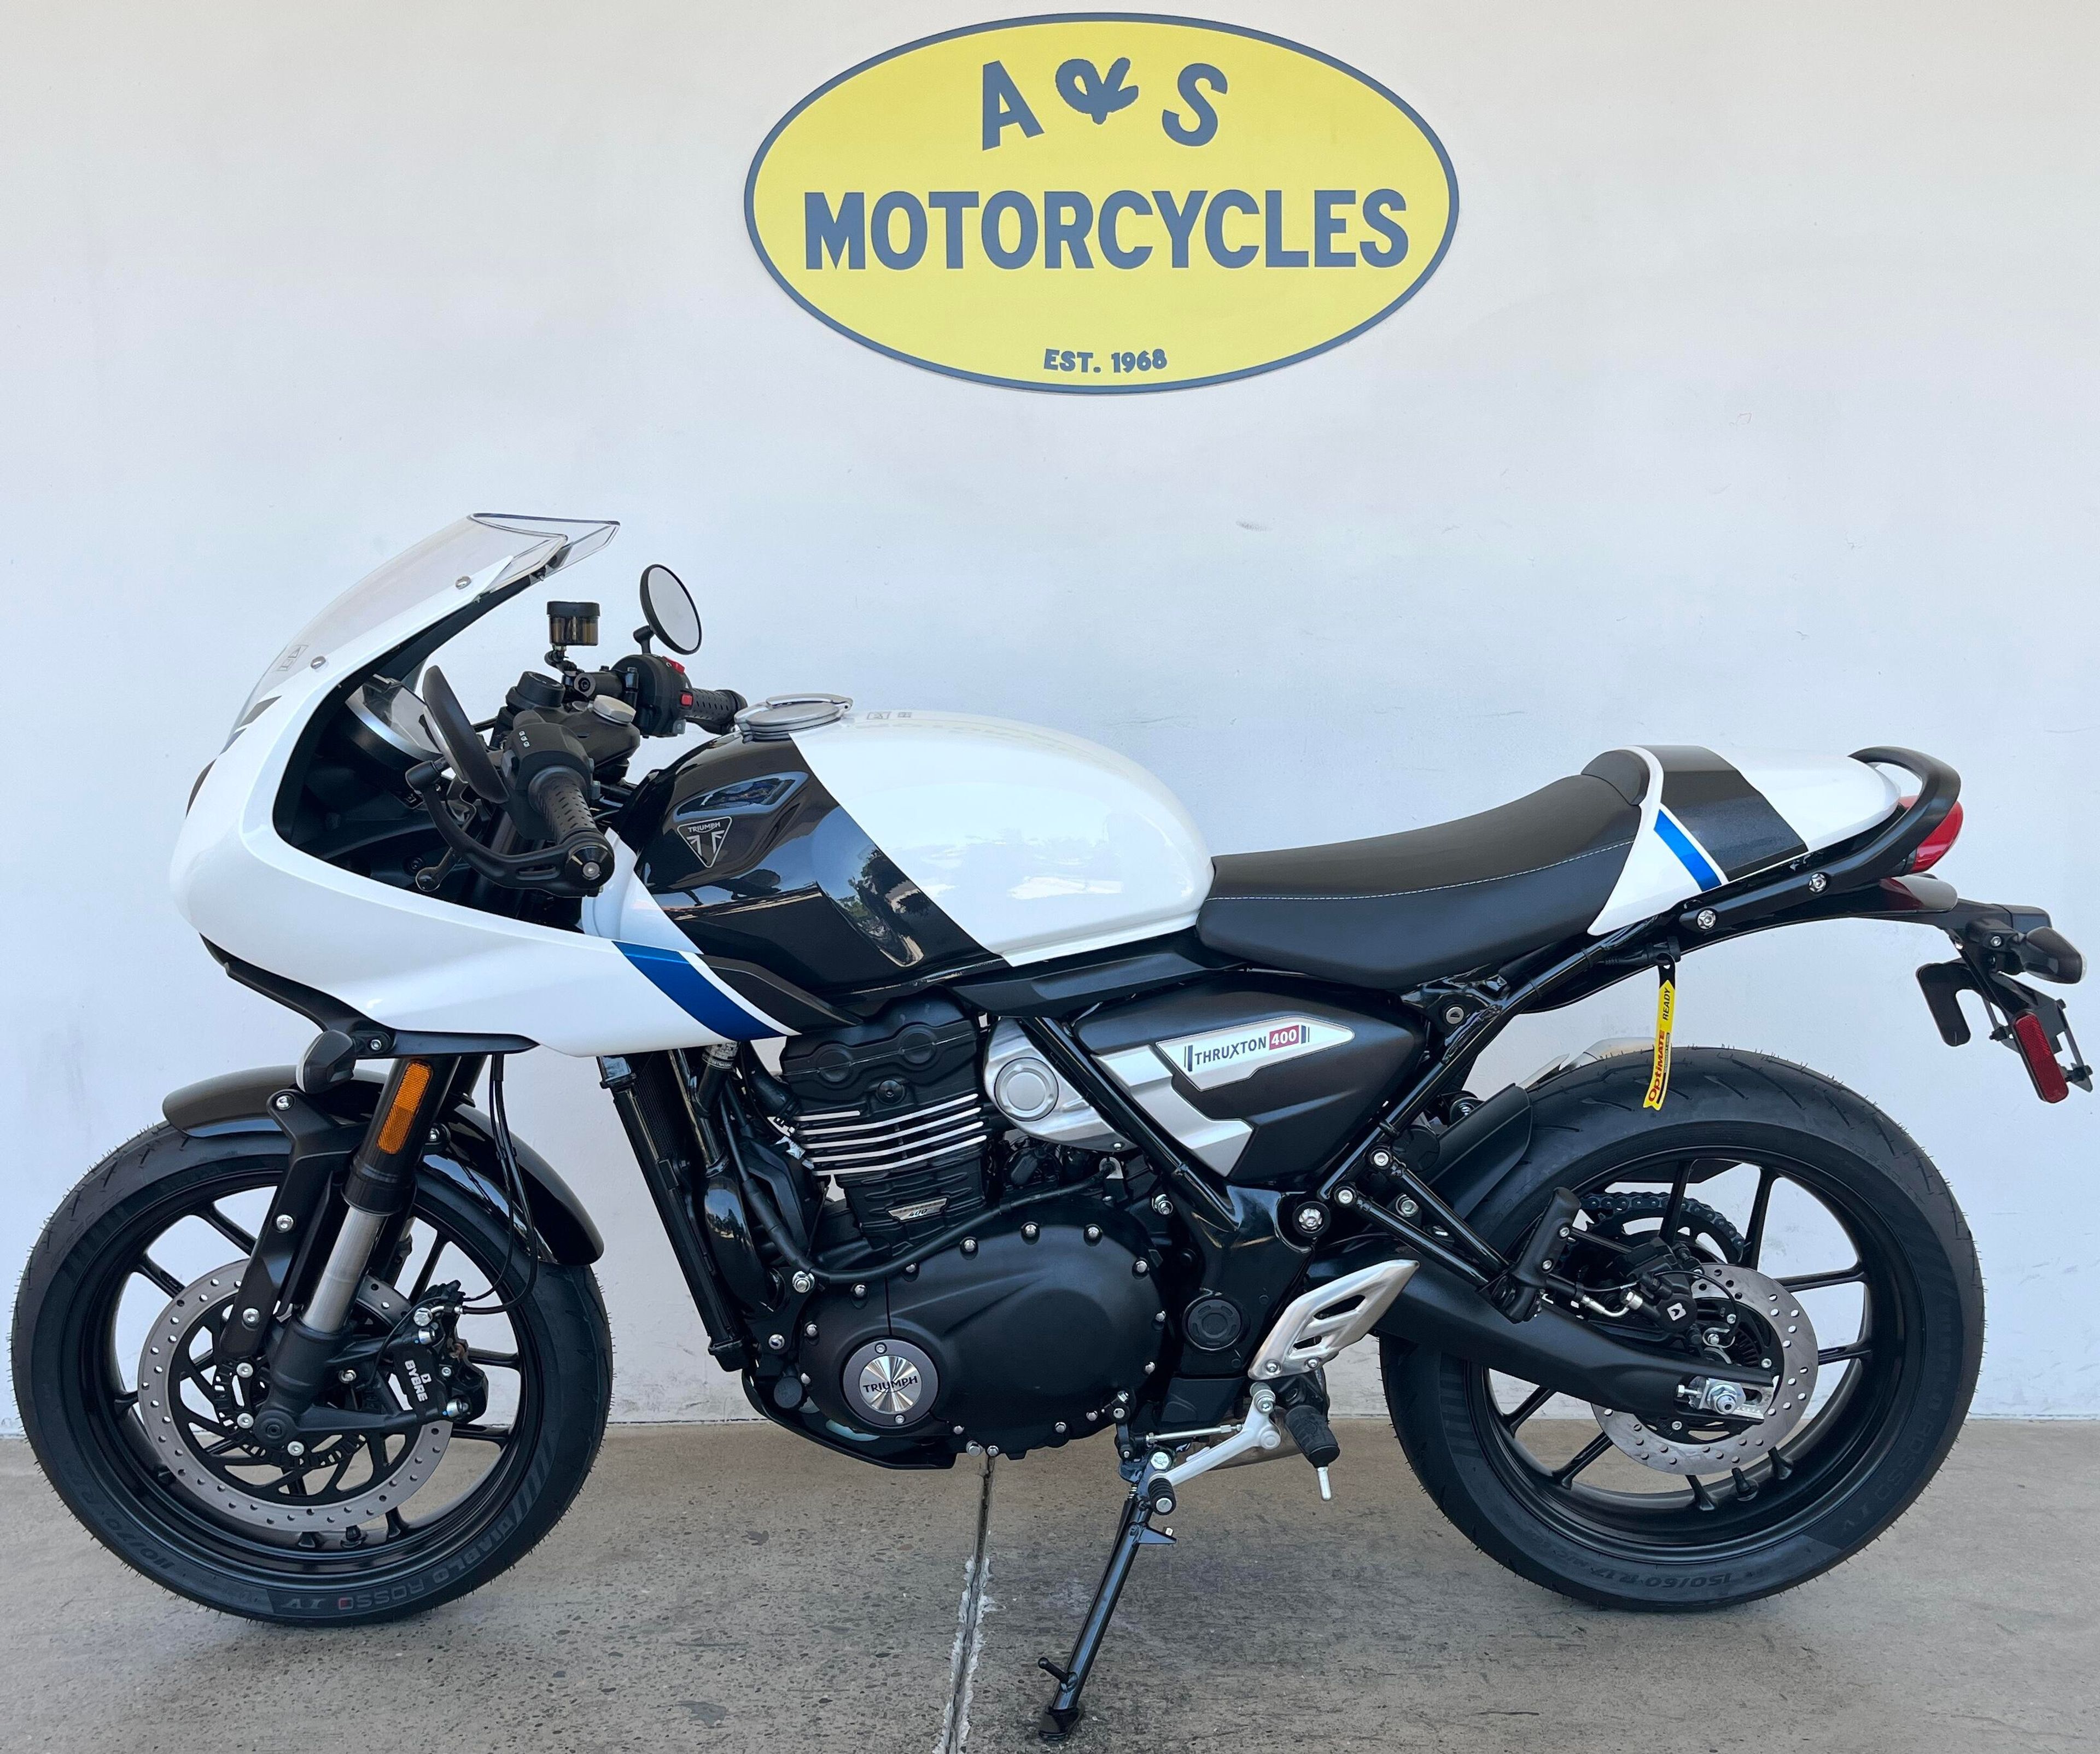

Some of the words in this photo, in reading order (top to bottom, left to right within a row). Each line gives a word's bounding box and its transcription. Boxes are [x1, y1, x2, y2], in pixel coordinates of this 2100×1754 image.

[982, 60, 1044, 150] A
[1162, 63, 1228, 147] S
[804, 189, 1409, 270] MOTORCYCLES
[1043, 348, 1100, 373] EST.
[1111, 348, 1168, 373] 1968
[688, 822, 721, 833] TRIUMPH
[1662, 987, 1671, 1021] READY
[1195, 1037, 1267, 1065] THRUXTON
[1271, 1028, 1297, 1046] 400
[908, 1208, 928, 1217] 400
[405, 1360, 428, 1402] BYBRE
[862, 1375, 918, 1393] TRIUMPH
[431, 1518, 515, 1584] DIABLO
[1644, 1572, 1732, 1587] 150/60
[337, 1583, 425, 1610] ROSSO
